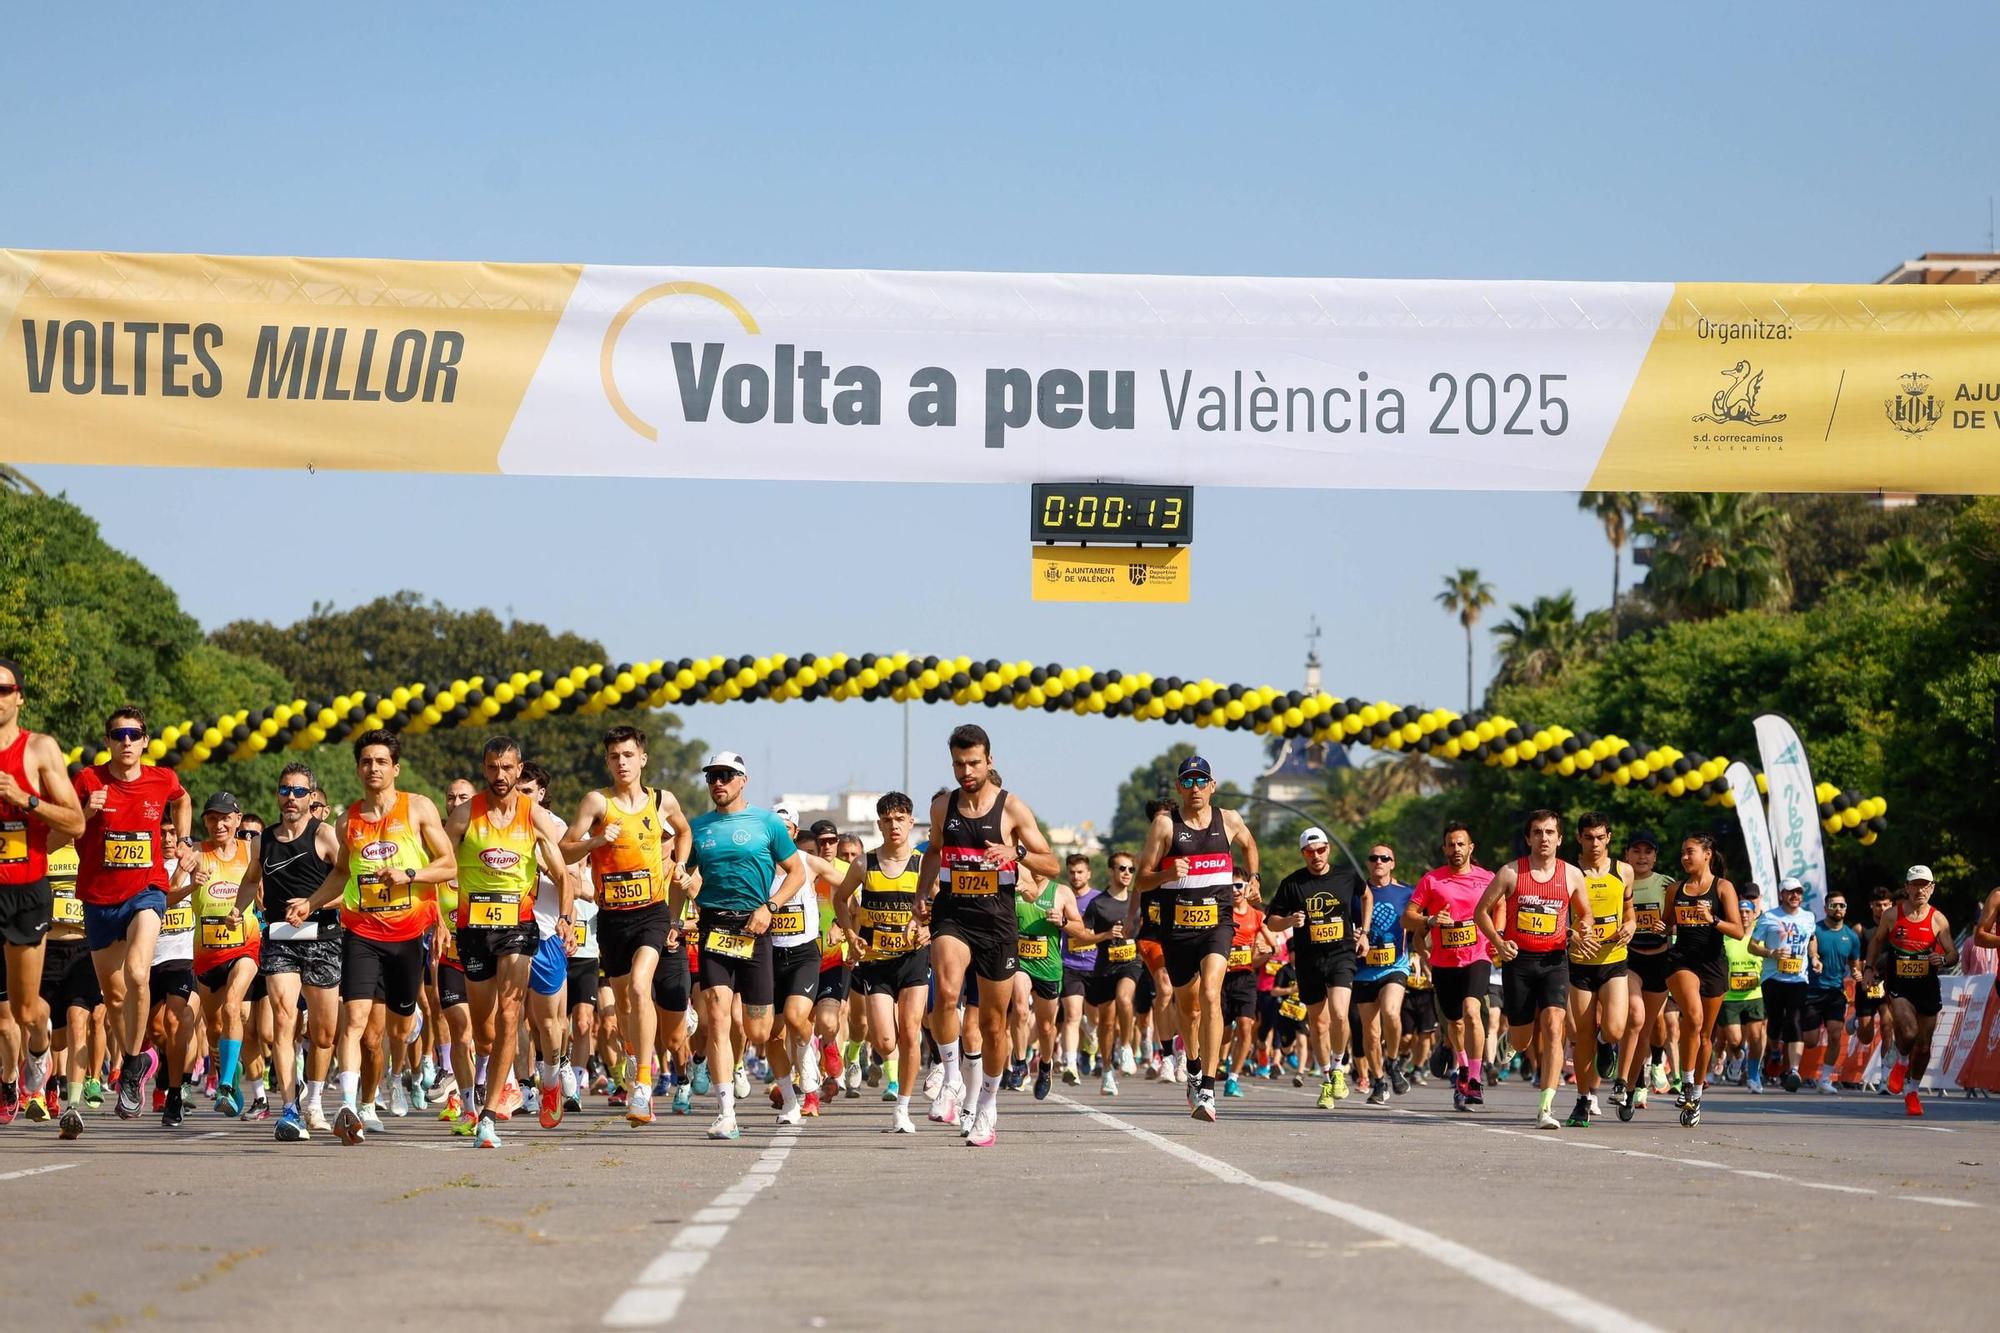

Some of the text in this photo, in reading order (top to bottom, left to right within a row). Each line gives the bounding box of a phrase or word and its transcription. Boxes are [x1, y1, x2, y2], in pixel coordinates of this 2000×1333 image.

[1697, 317, 1792, 344] Organitza:
[22, 319, 464, 402] VOLTES MILLOR
[671, 343, 1569, 448] Volta a peu València 2025
[1953, 410, 1986, 429] DE
[1693, 433, 1783, 442] s.d. correcaminos
[1064, 567, 1115, 575] AJUNTAMENT
[114, 845, 144, 860] 2762
[364, 845, 396, 857] Serrano
[483, 853, 518, 864] Serrano
[1195, 859, 1227, 870] POBLA
[958, 876, 989, 890] 9724
[378, 888, 391, 902] 41
[612, 883, 643, 900] 3950
[892, 902, 912, 910] VESP
[485, 907, 502, 921] 45
[1182, 910, 1210, 923] 2523
[1531, 916, 1543, 929] 14
[215, 929, 230, 941] 44
[1316, 926, 1338, 938] 4567
[1447, 930, 1471, 942] 3893
[1019, 942, 1042, 955] 8935
[1373, 952, 1390, 963] 4118
[1902, 963, 1925, 974] 2525
